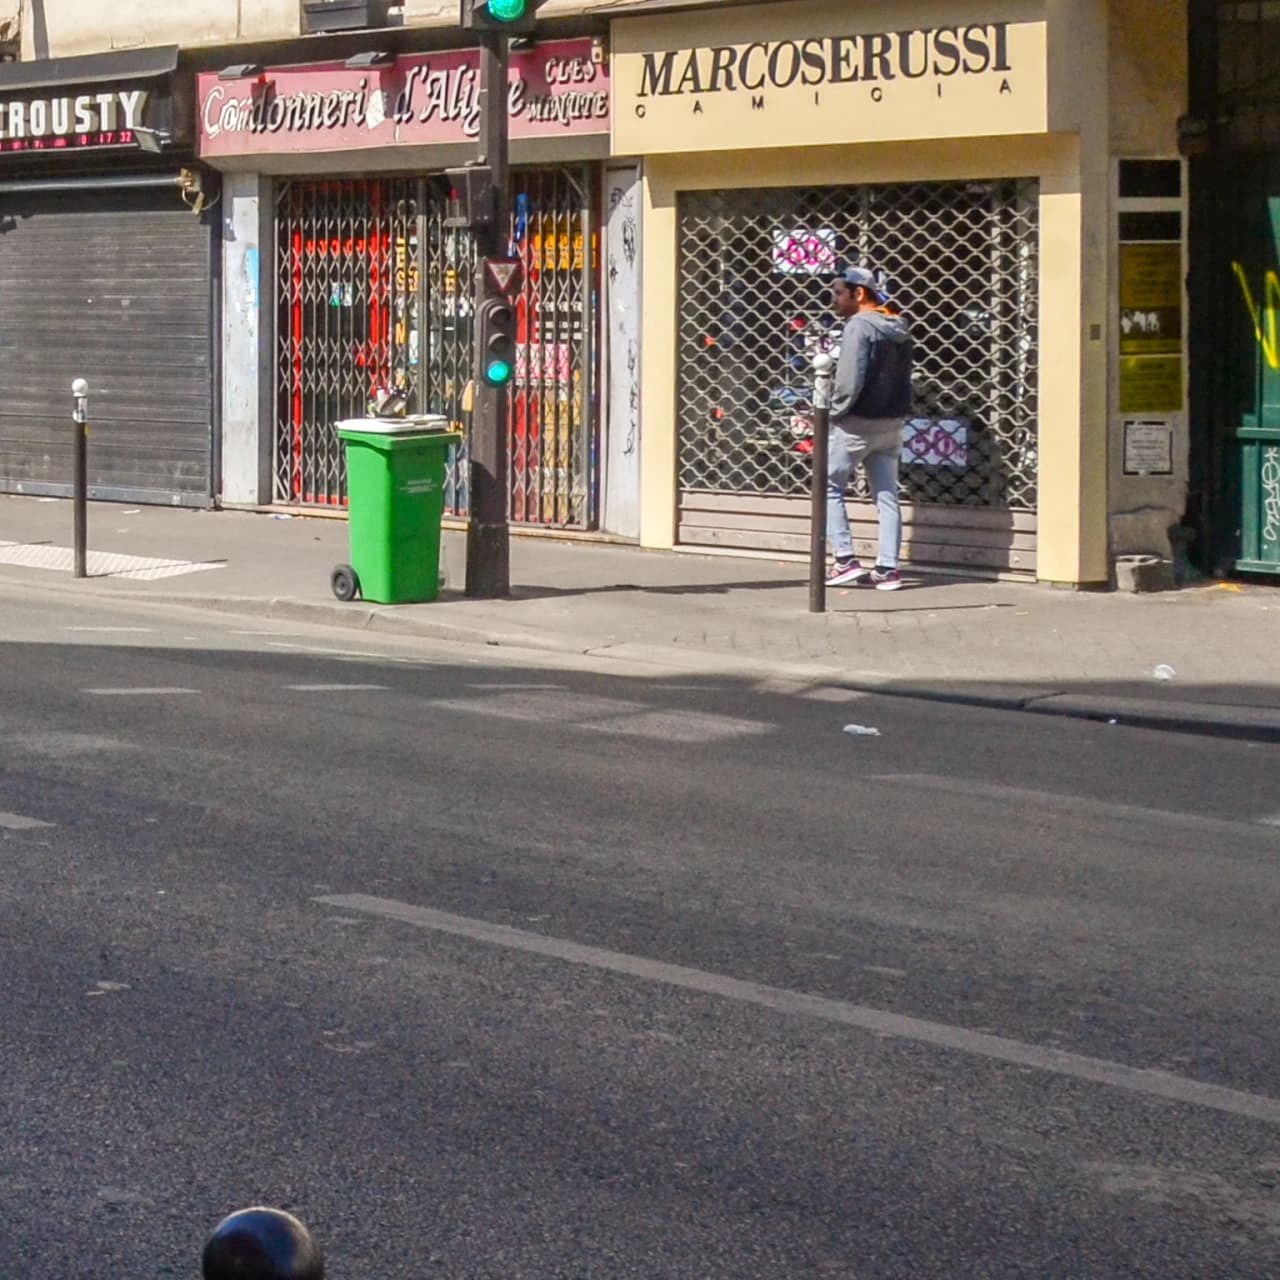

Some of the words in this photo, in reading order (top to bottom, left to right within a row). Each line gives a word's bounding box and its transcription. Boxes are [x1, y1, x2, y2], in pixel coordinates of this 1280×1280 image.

[636, 22, 1012, 98] MARCOSERUSSI
[202, 77, 378, 139] Cordonneri
[526, 90, 609, 125] MINUTE
